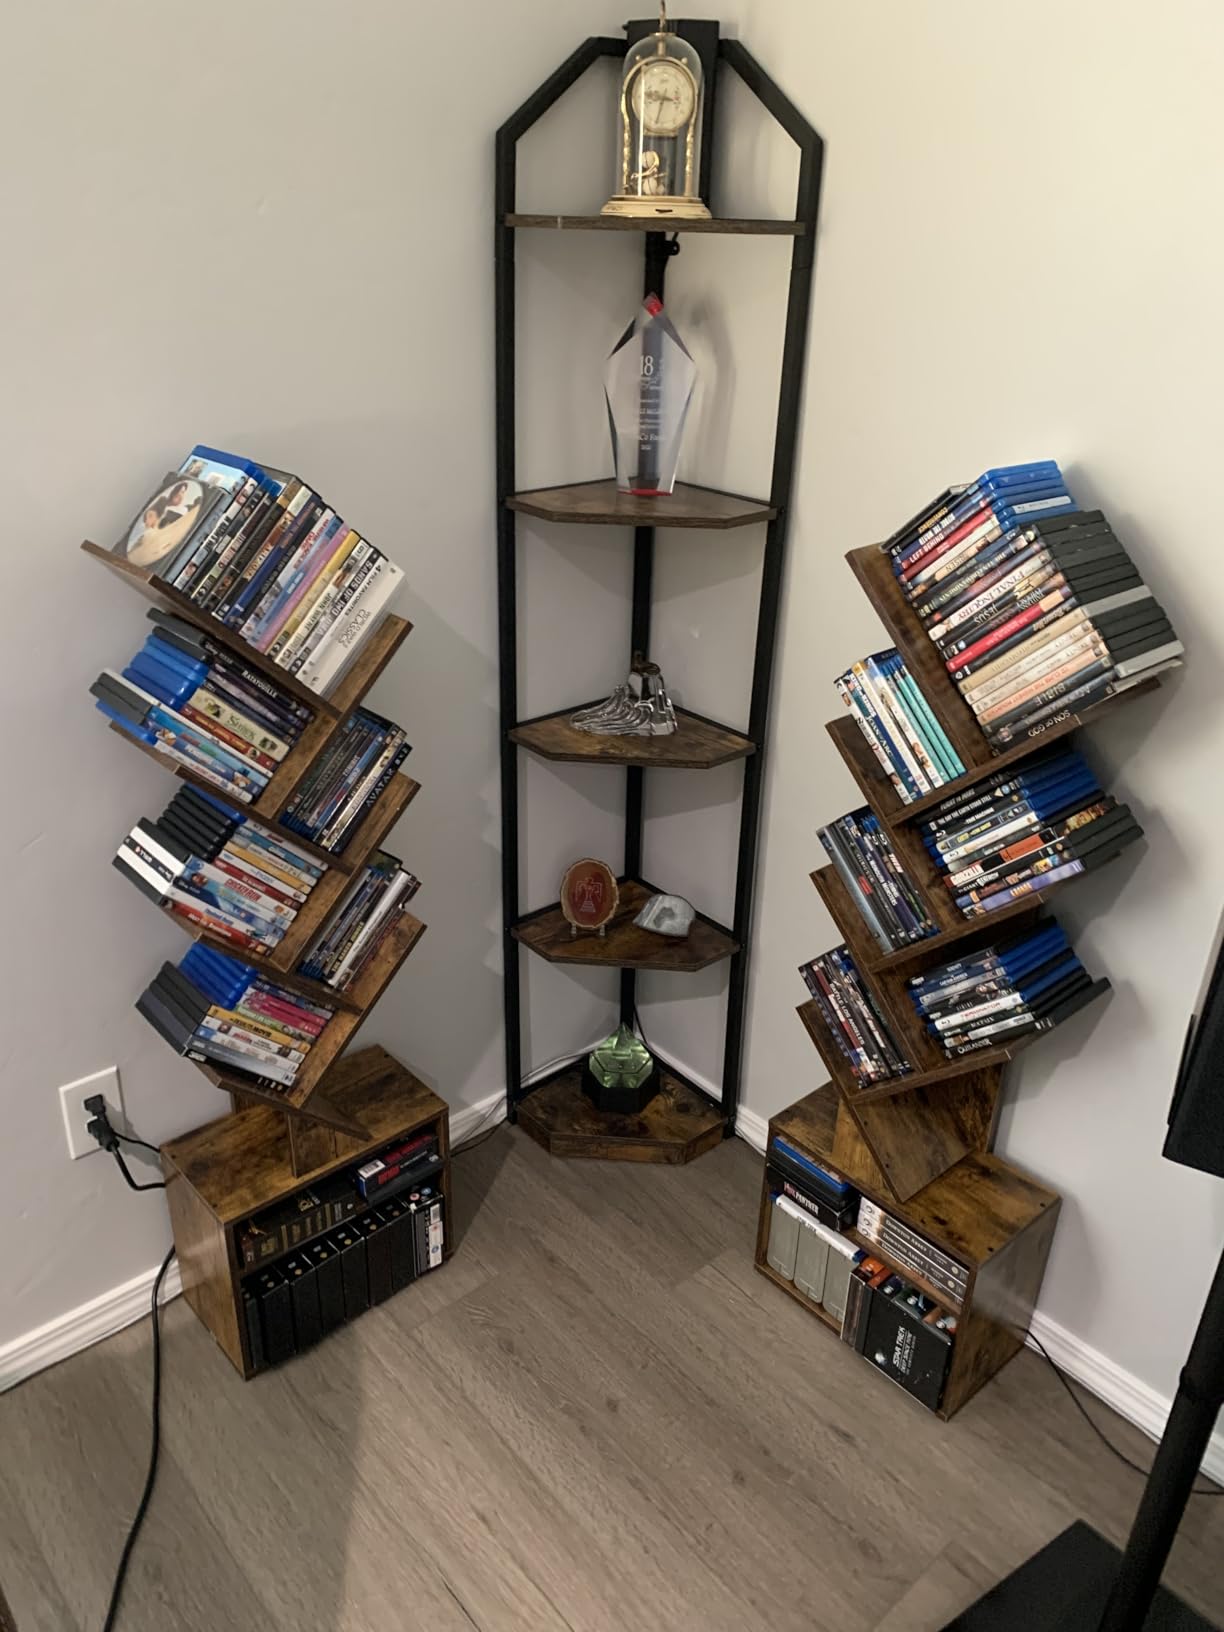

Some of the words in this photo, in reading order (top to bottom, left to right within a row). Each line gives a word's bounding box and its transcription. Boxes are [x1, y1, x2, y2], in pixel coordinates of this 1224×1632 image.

[908, 548, 924, 563] LEFT
[922, 532, 945, 552] BEHIND
[349, 560, 373, 588] SANDS
[364, 571, 378, 587] FILM
[375, 564, 382, 572] 4
[341, 587, 354, 601] OF
[937, 568, 983, 602] COMMANDMENTS
[993, 570, 1025, 595] FINAL
[318, 592, 333, 609] JOHN
[344, 586, 367, 616] FAVORITES
[956, 591, 994, 620] INQUIRY
[303, 609, 321, 631] WAYNE
[337, 608, 366, 645] CLASSICS
[973, 604, 998, 625] JESUS
[240, 669, 278, 698] RATATOUILLE
[1032, 682, 1066, 706] BIBLE
[1053, 709, 1071, 725] SON
[865, 714, 880, 735] JOAN
[879, 738, 893, 757] ARC
[1027, 722, 1047, 738] GOD
[364, 767, 394, 807] AVATAR
[939, 798, 955, 810] FLIGHT
[960, 789, 975, 800] MARS
[957, 805, 970, 814] EARTH
[969, 799, 981, 808] STOOD
[981, 794, 991, 803] STILL
[974, 807, 993, 819] MACHINE
[949, 863, 984, 886] GODZILLA
[962, 881, 978, 891] GIANT
[223, 877, 248, 895] CHICKEN
[244, 888, 262, 903] RUN
[881, 881, 897, 906] MONSTERS
[841, 1005, 850, 1018] LOS
[847, 1017, 865, 1045] ANGELES
[792, 1191, 822, 1215] PANTHER
[884, 1219, 911, 1240] DOWNTON
[910, 1237, 927, 1252] ABBEY
[881, 1232, 908, 1253] DOWNTON
[907, 1250, 924, 1265] ABBEY
[894, 1325, 906, 1346] TREK
[890, 1345, 902, 1367] STAR
[902, 1344, 911, 1360] SPACE
